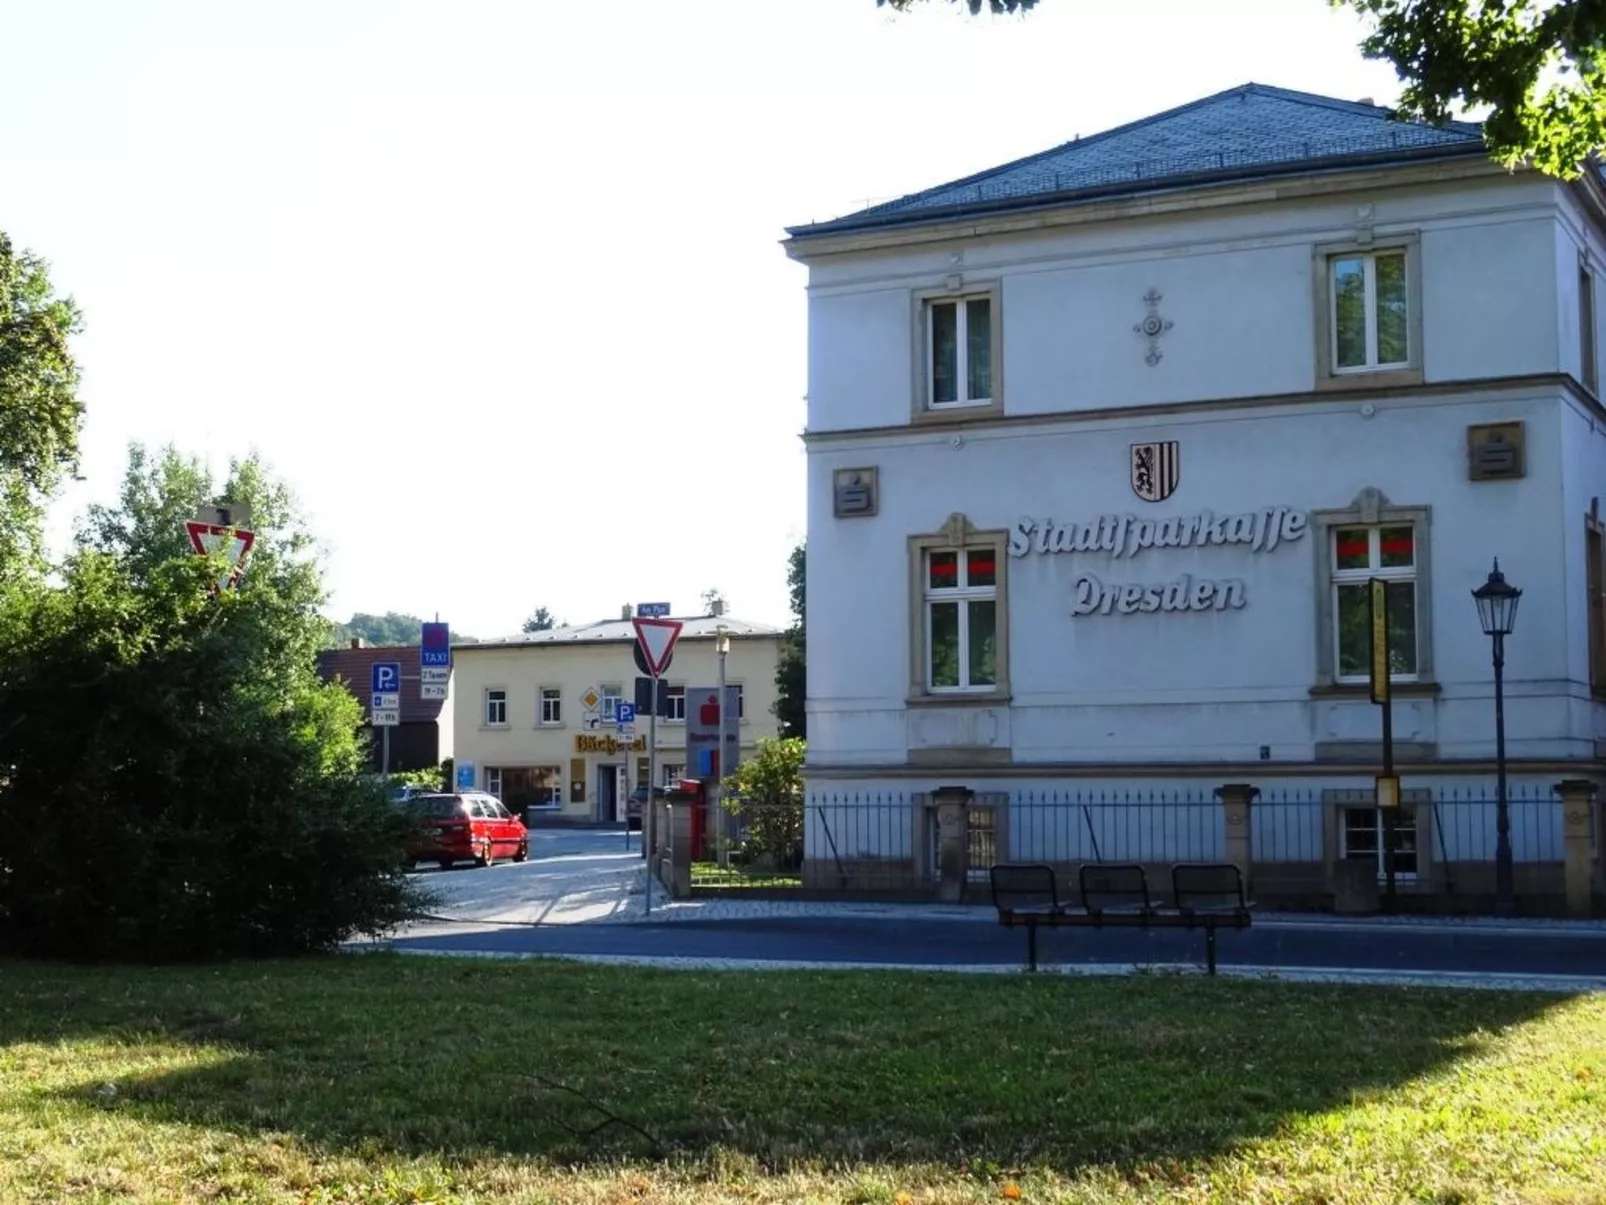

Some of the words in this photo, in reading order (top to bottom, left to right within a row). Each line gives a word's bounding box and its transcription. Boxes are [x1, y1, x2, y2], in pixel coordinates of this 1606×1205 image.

[1071, 572, 1250, 617] Dresden
[424, 652, 447, 663] TAXI
[378, 666, 393, 689] P
[620, 705, 631, 720] P
